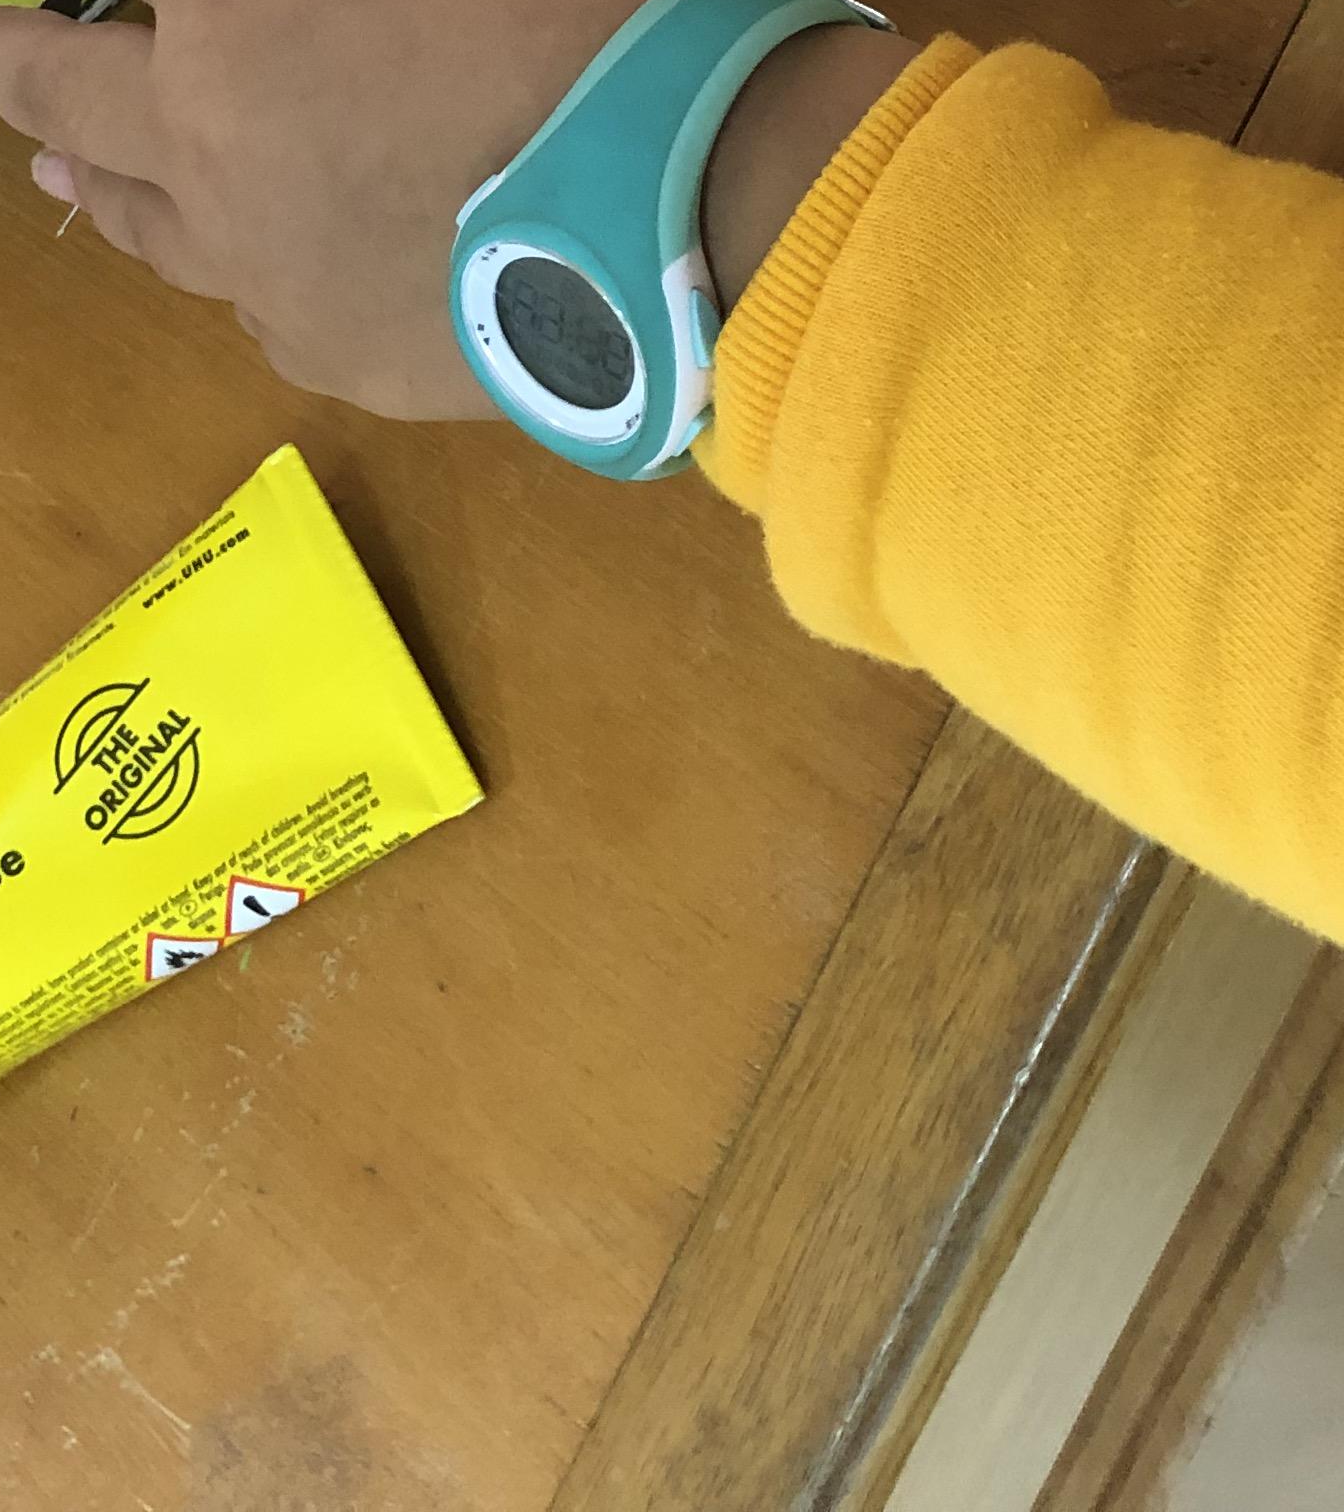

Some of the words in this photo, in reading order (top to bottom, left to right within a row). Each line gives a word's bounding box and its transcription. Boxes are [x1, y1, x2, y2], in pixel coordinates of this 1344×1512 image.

[142, 528, 249, 608] www.UHU.com
[84, 709, 190, 830] ORIGINAL
[91, 723, 139, 774] THE
